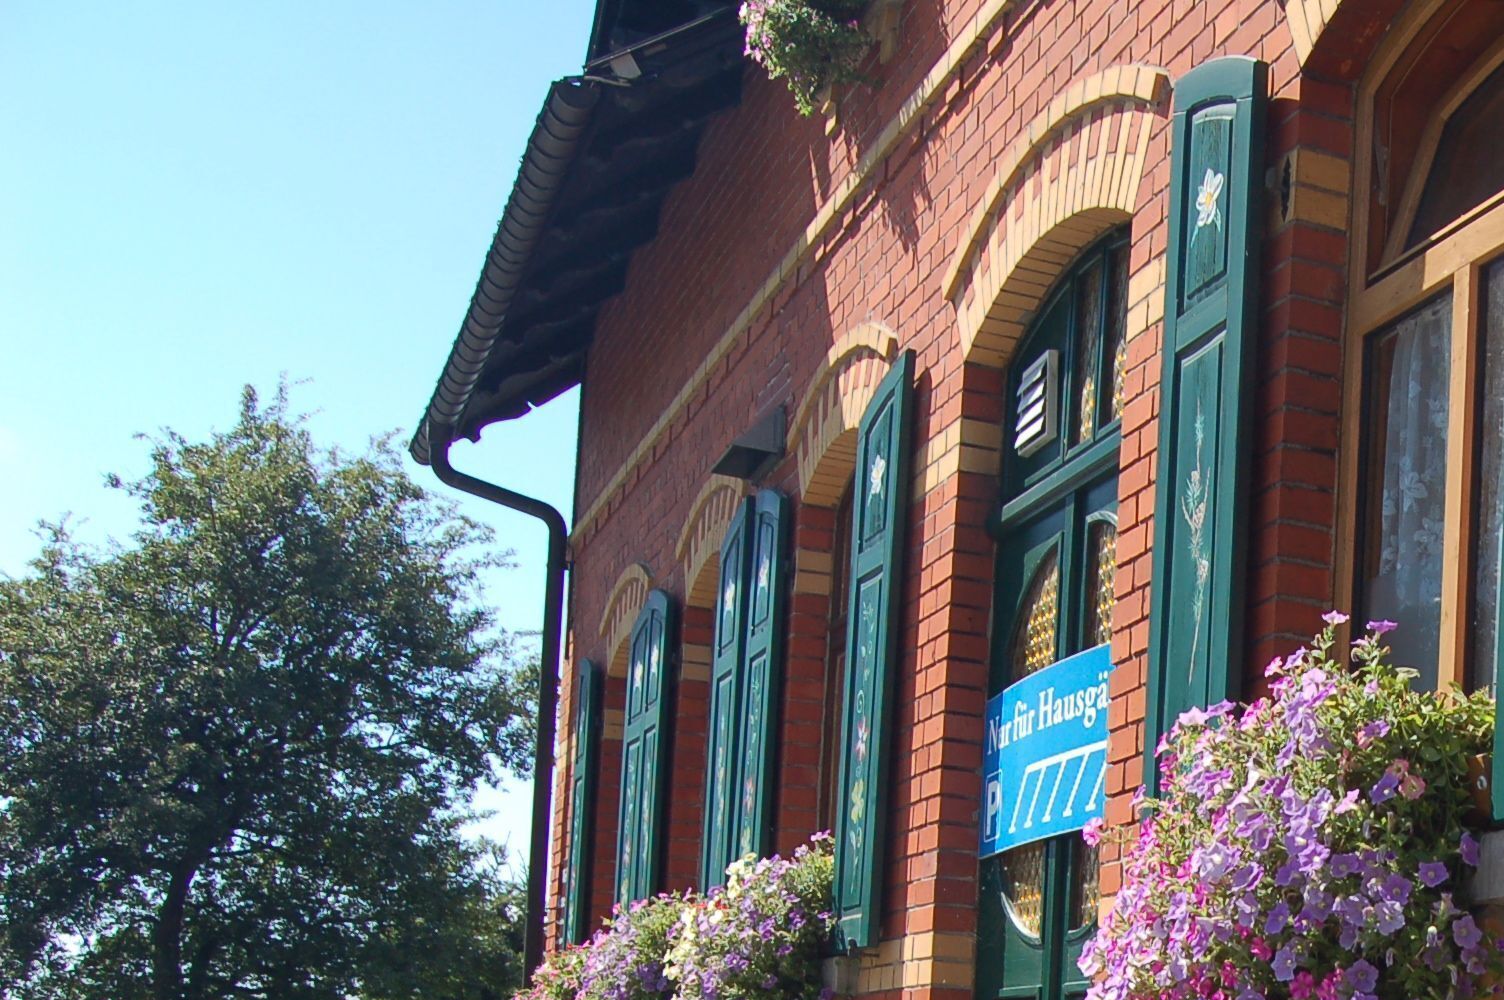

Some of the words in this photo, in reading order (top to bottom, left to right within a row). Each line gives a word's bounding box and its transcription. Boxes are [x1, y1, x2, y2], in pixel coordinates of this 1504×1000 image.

[987, 715, 1012, 755] Nur
[1012, 700, 1035, 742] für
[986, 780, 1000, 836] P
